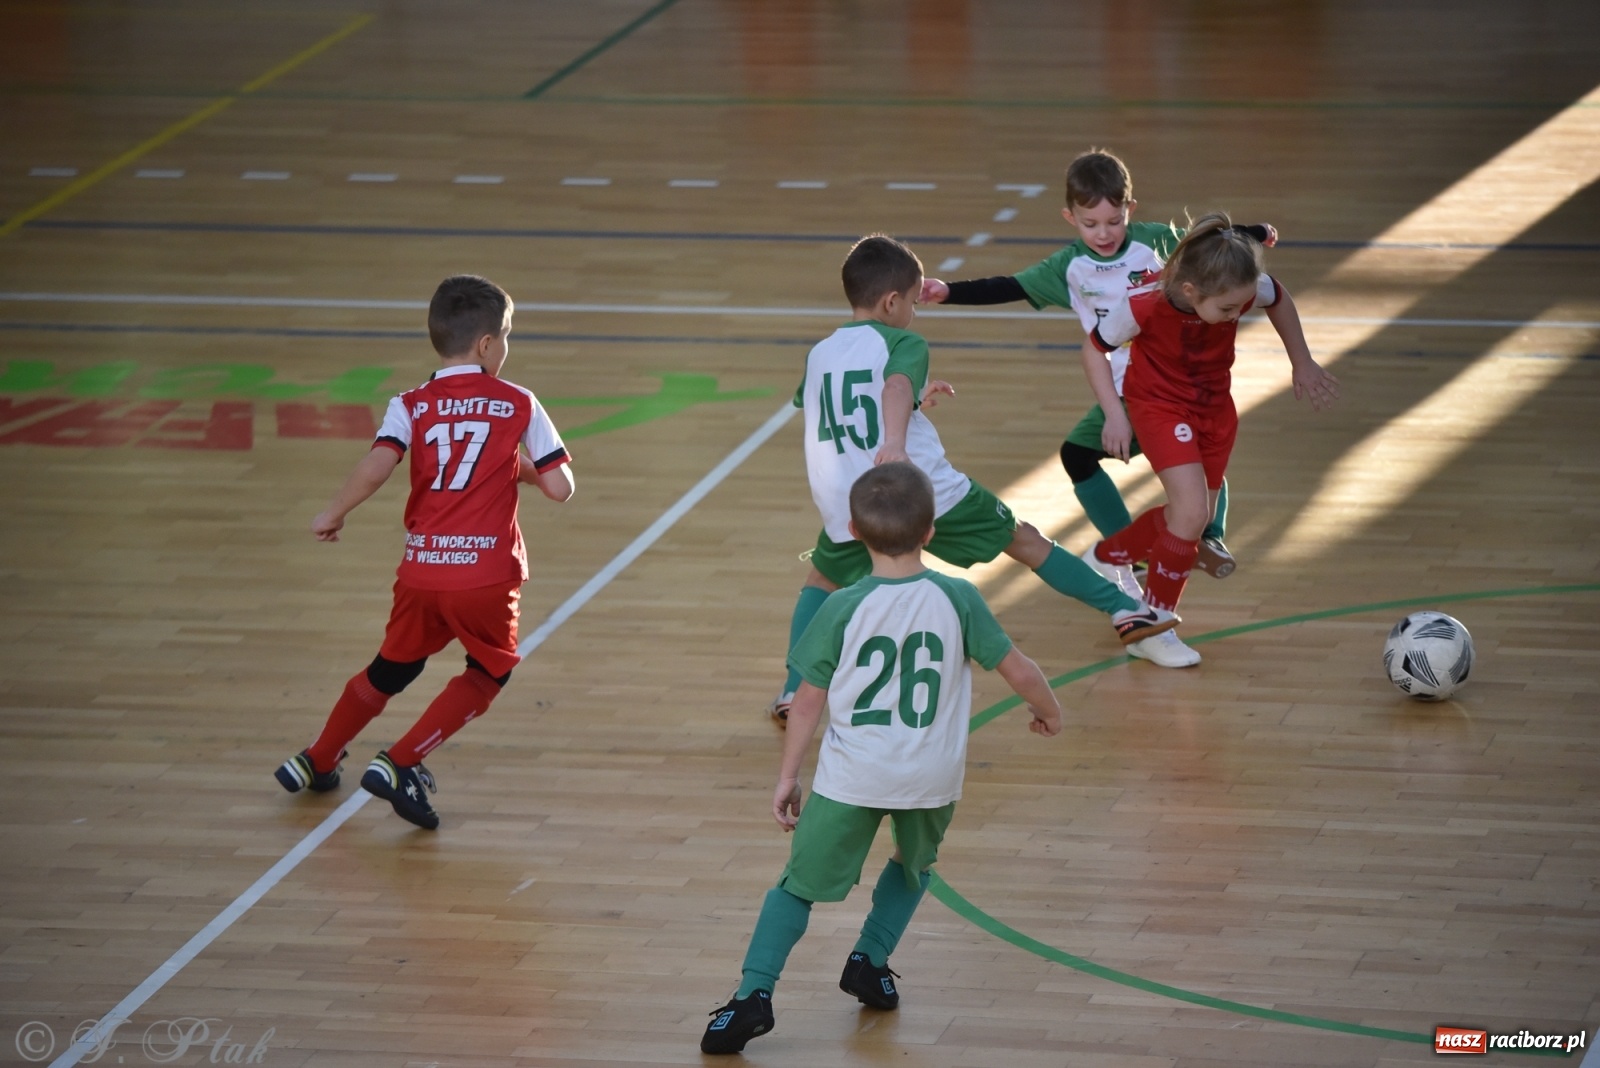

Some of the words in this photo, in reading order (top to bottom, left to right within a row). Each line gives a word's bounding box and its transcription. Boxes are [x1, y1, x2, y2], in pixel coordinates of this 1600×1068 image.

[437, 396, 515, 419] UNITED
[818, 369, 879, 455] 45
[424, 420, 491, 492] 17
[417, 550, 479, 564] WIELKIEGO
[432, 535, 498, 549] TWORZYMY
[851, 631, 944, 729] 26
